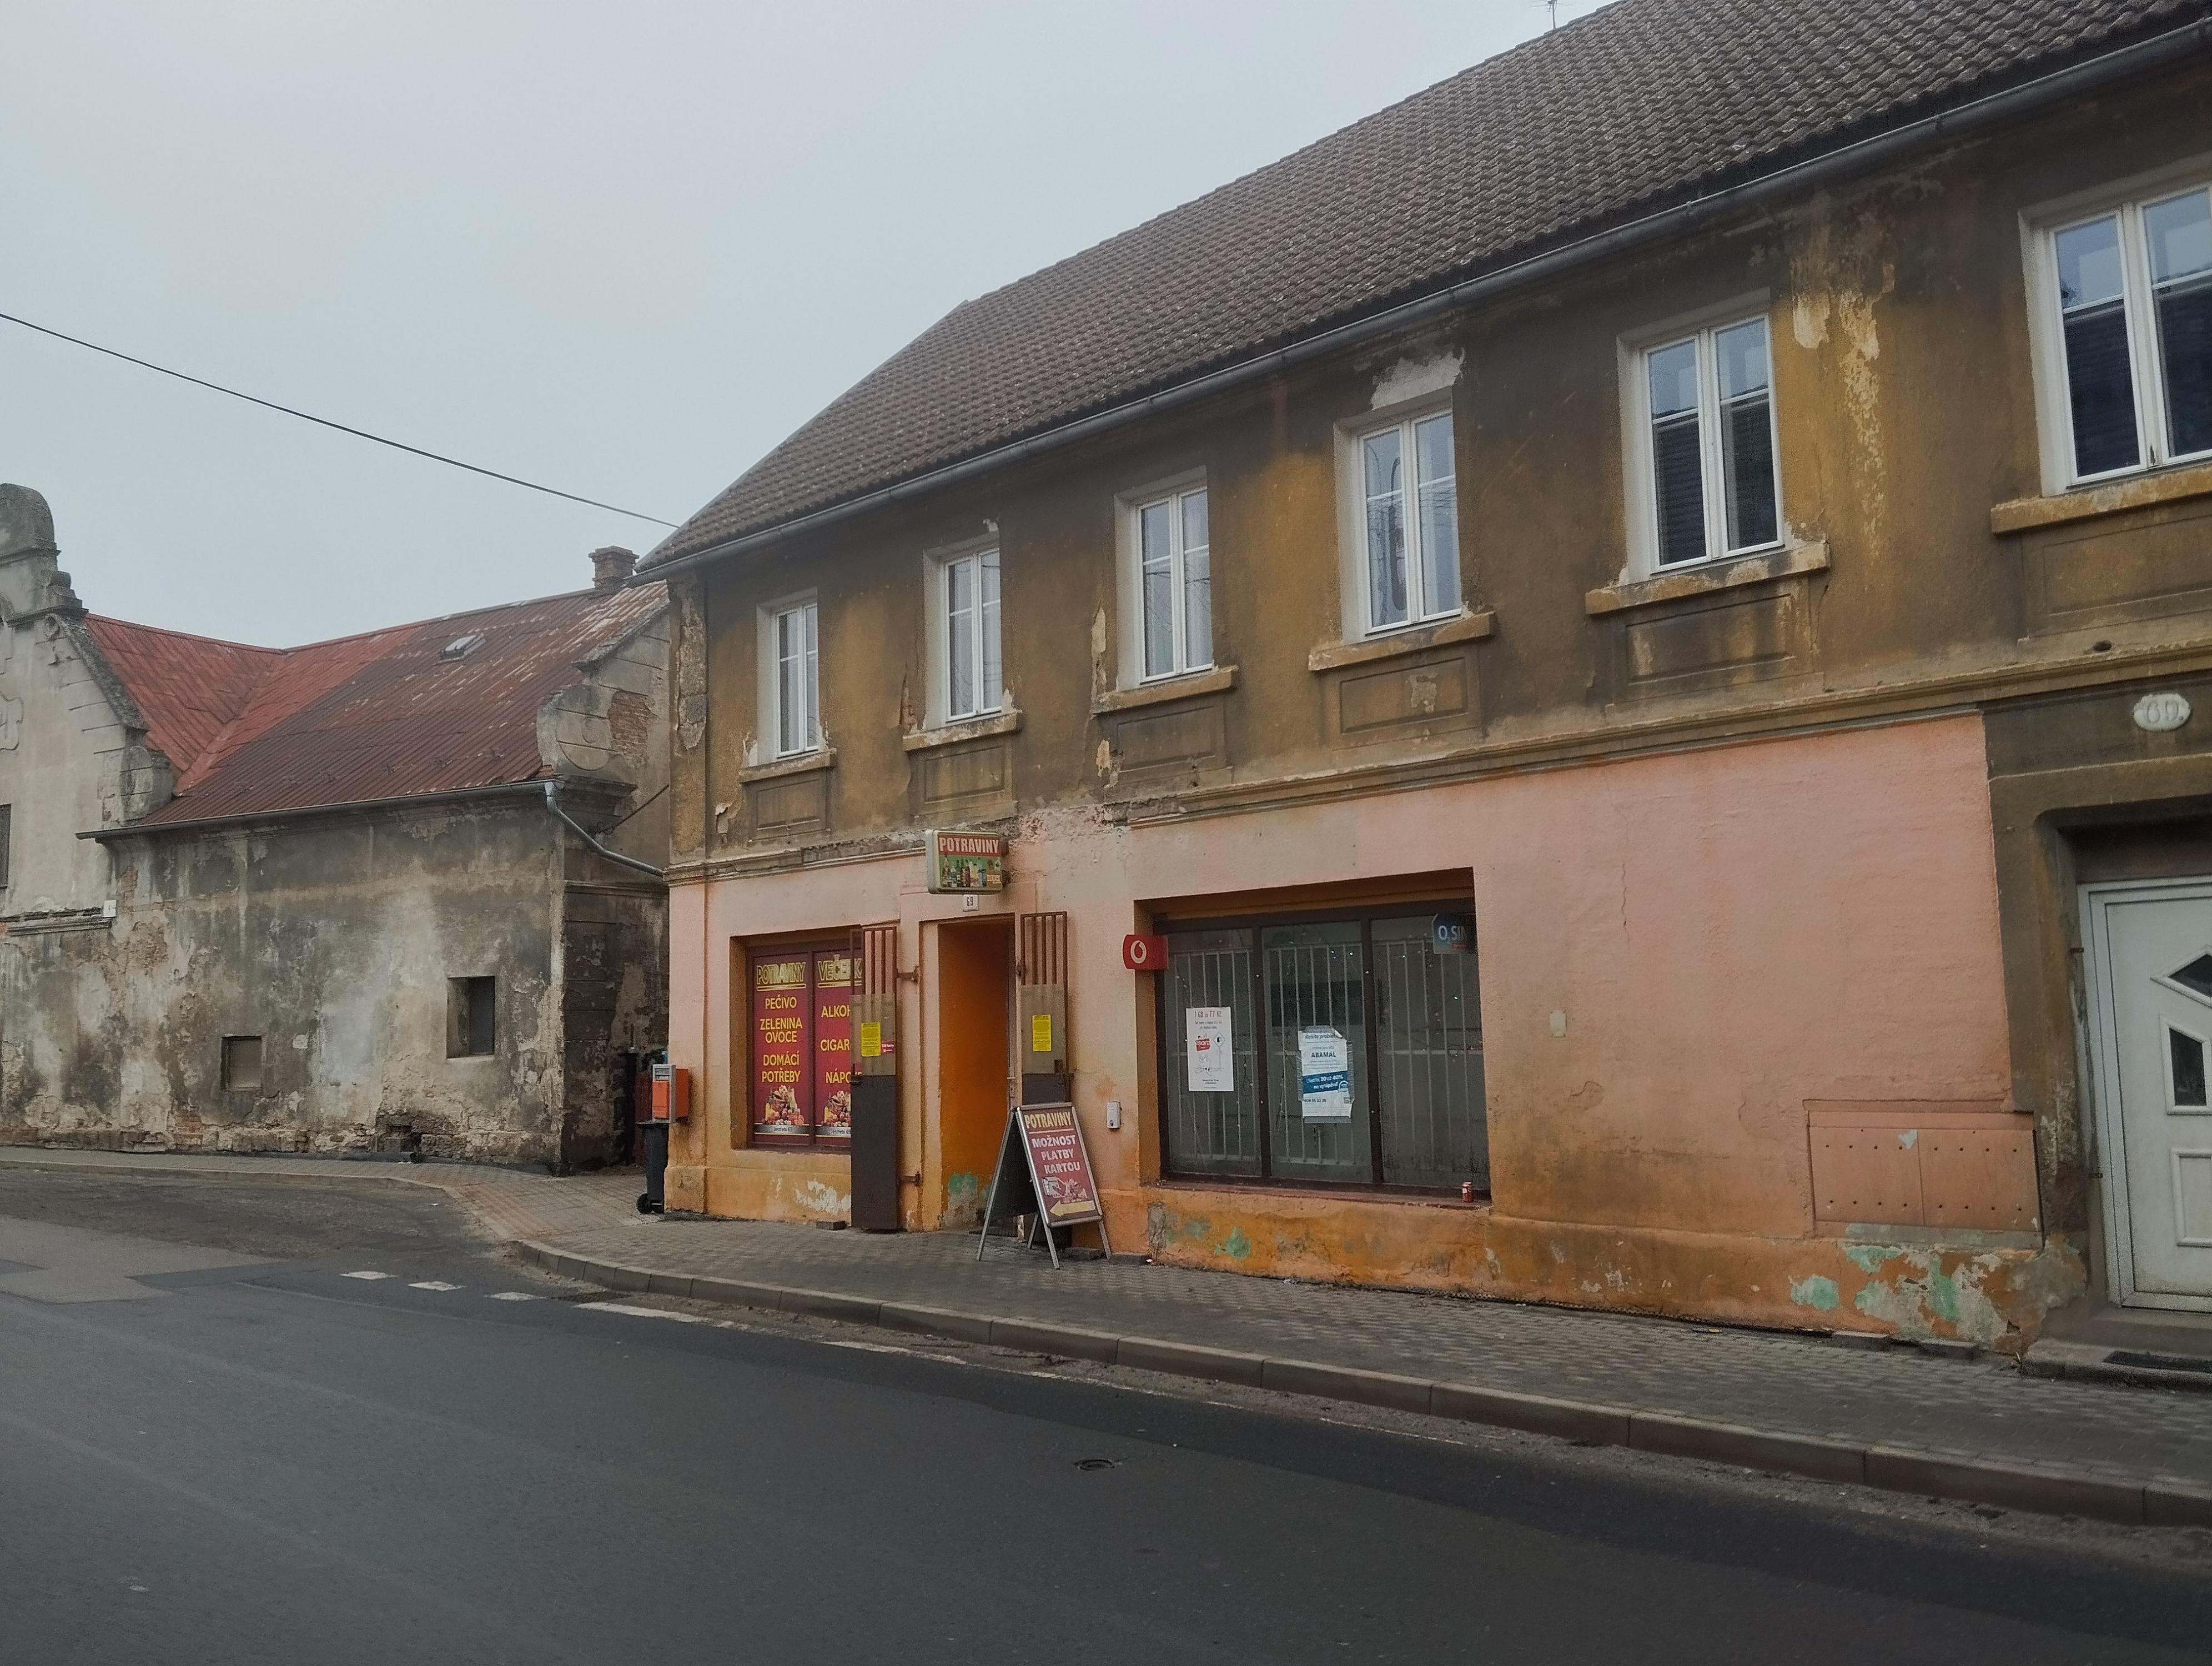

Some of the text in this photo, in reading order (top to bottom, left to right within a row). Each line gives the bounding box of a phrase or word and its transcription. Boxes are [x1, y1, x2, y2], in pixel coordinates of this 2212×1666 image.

[939, 837, 999, 854] POTRAVINY
[966, 896, 973, 906] 69
[757, 962, 806, 985] POTRAVINY
[765, 994, 797, 1009] PEČIVO
[760, 1017, 803, 1030] ZELENINA
[765, 1031, 797, 1043] OVOCE
[763, 1050, 800, 1066] DOMÁCÍ
[762, 1068, 801, 1083] POTŘEBY
[1024, 1111, 1072, 1129] POTRAVINY
[1032, 1135, 1076, 1148] MOŽNOST
[1041, 1148, 1074, 1161] PLATBY
[1044, 1161, 1080, 1174] KARTOU
